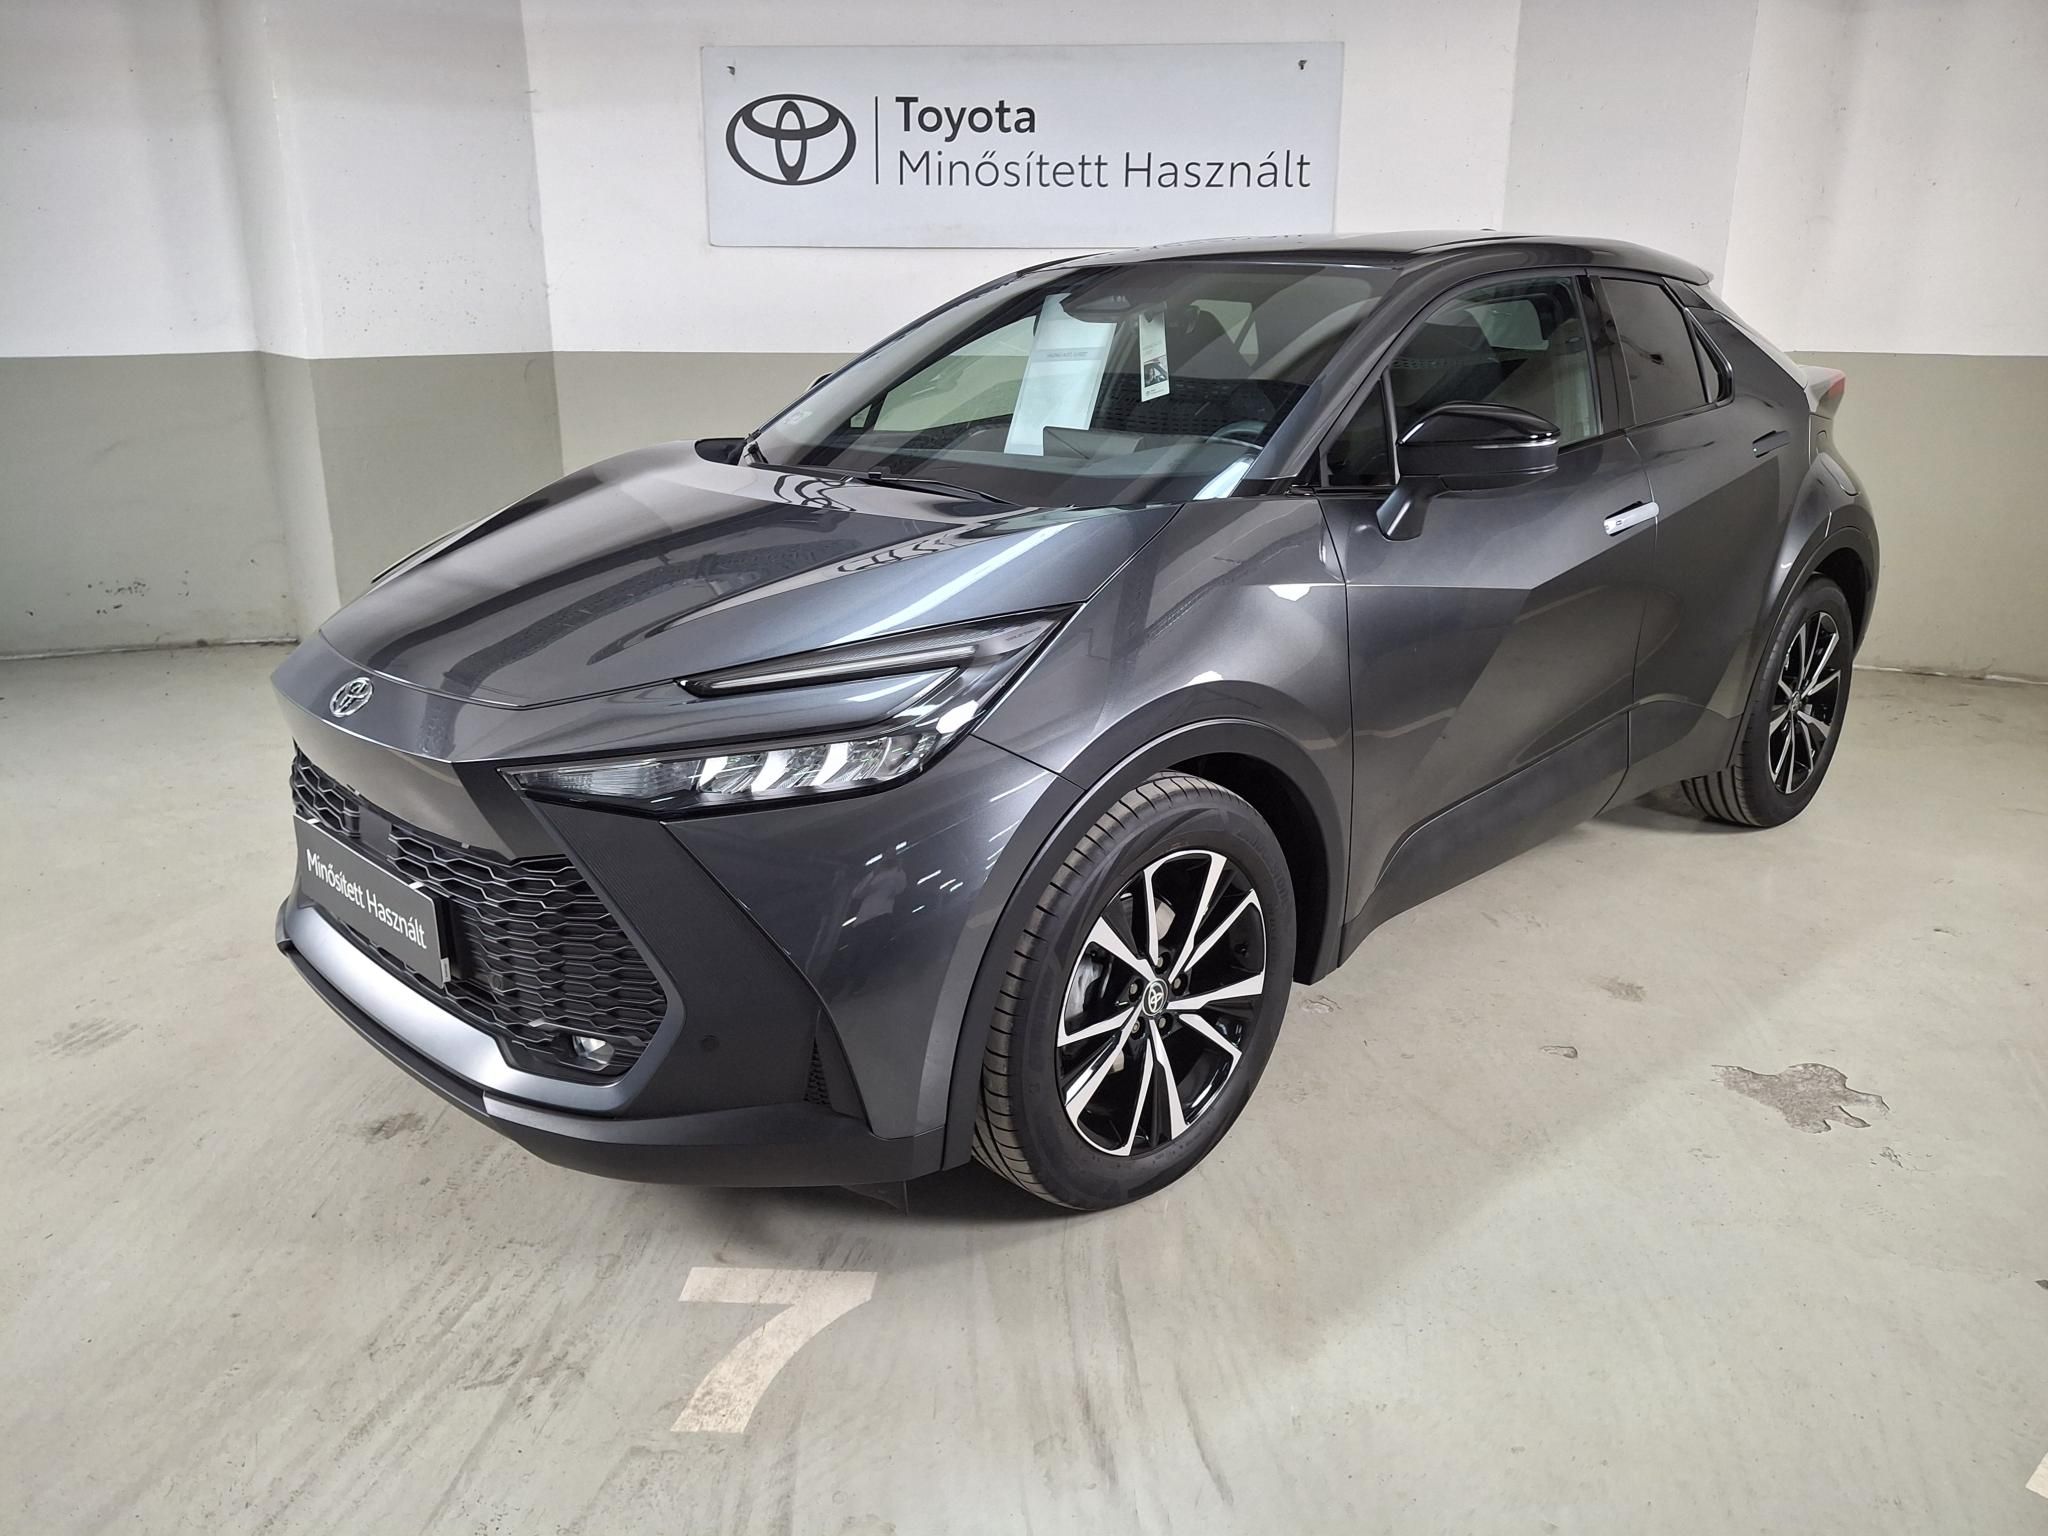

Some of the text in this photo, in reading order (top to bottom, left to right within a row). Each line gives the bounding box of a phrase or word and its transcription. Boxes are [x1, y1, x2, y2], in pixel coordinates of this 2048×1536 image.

[895, 96, 1036, 143] Toyota
[899, 149, 1311, 188] Minősített Használt
[306, 848, 427, 950] Minősített Használt
[669, 1266, 878, 1434] 7
